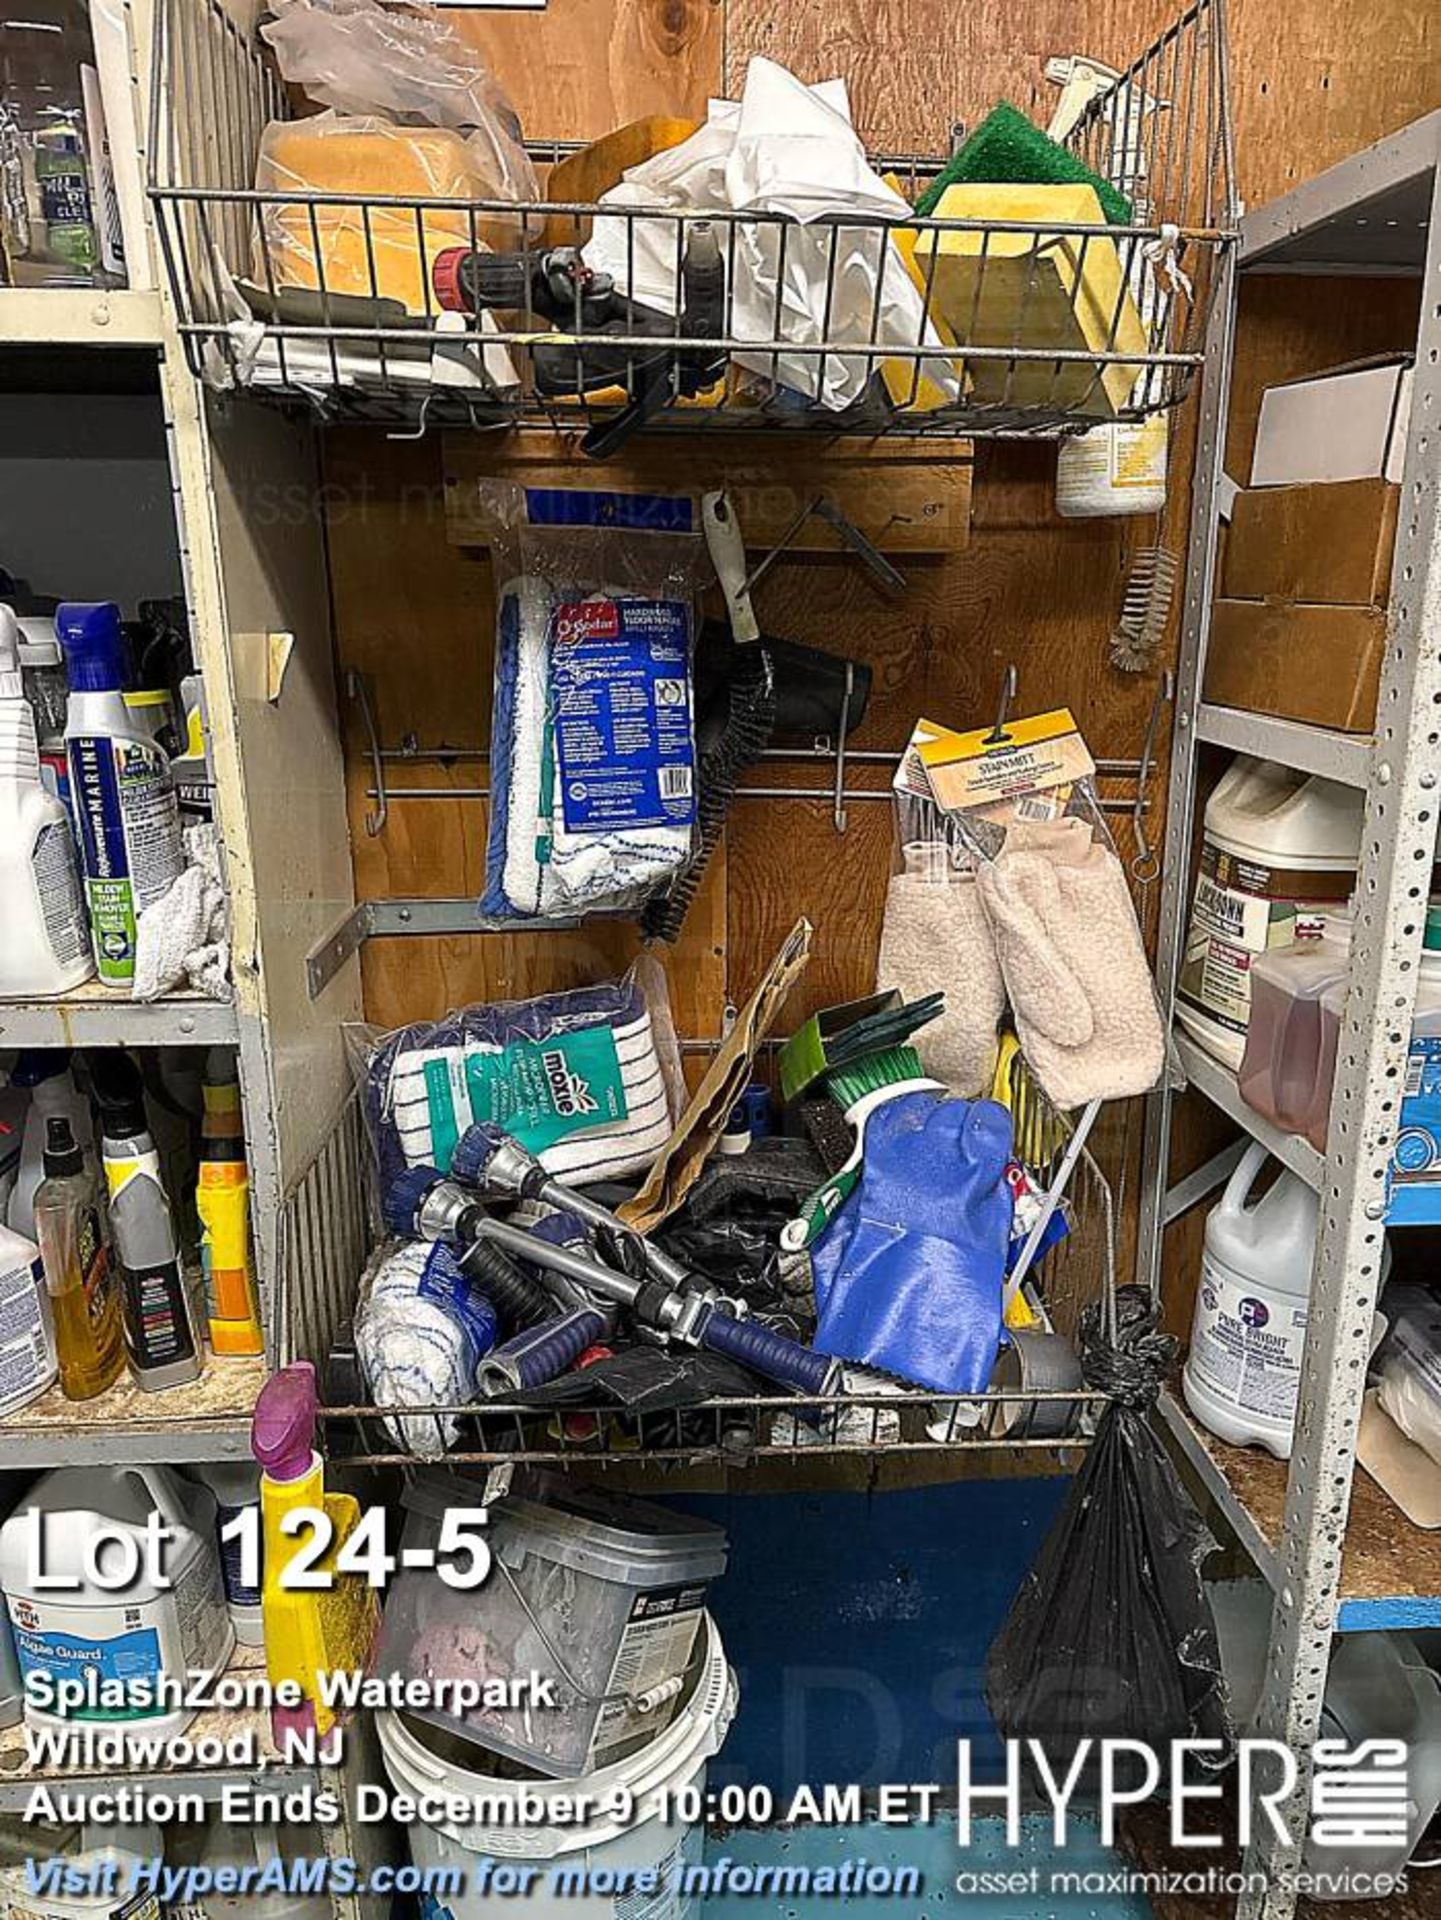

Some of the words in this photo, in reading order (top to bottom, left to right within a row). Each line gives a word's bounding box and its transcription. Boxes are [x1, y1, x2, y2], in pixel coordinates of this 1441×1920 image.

[79, 739, 105, 814] MARINE
[544, 1053, 575, 1115] moxie
[20, 1636, 55, 1656] Algae
